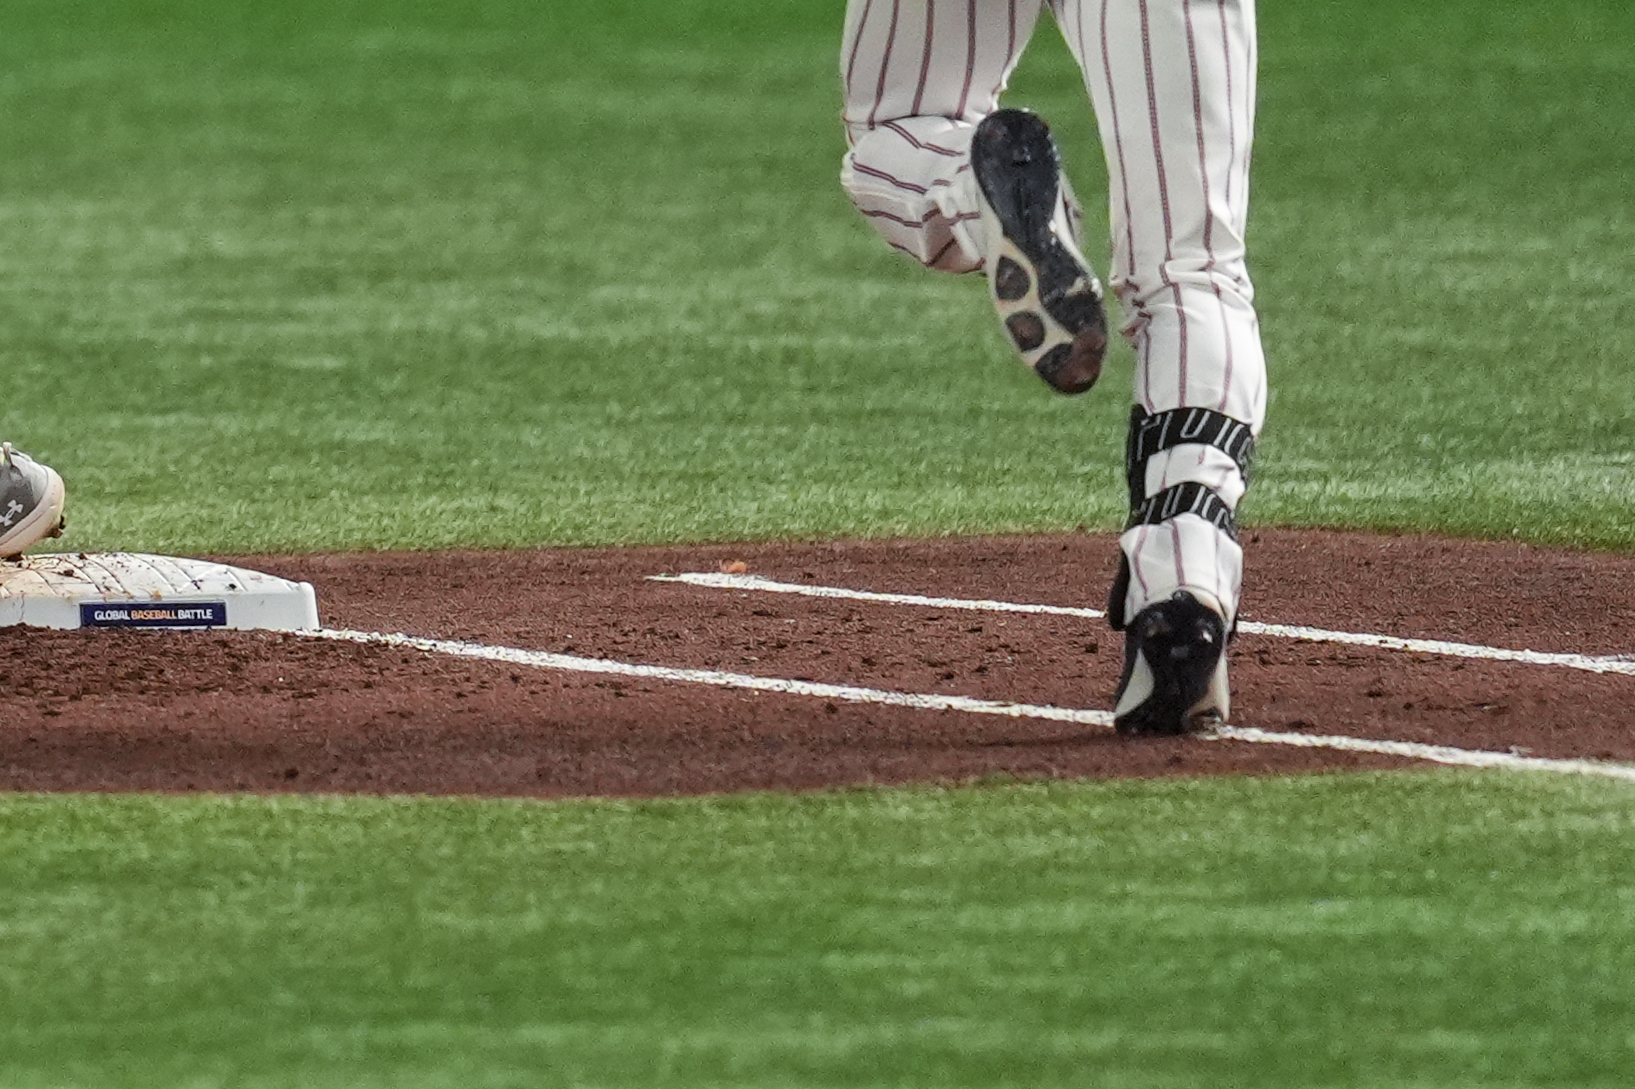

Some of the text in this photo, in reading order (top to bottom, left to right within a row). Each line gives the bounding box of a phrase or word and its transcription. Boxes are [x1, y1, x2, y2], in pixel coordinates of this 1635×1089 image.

[94, 609, 213, 621] GLOBAL BASEBALL BATTLE
